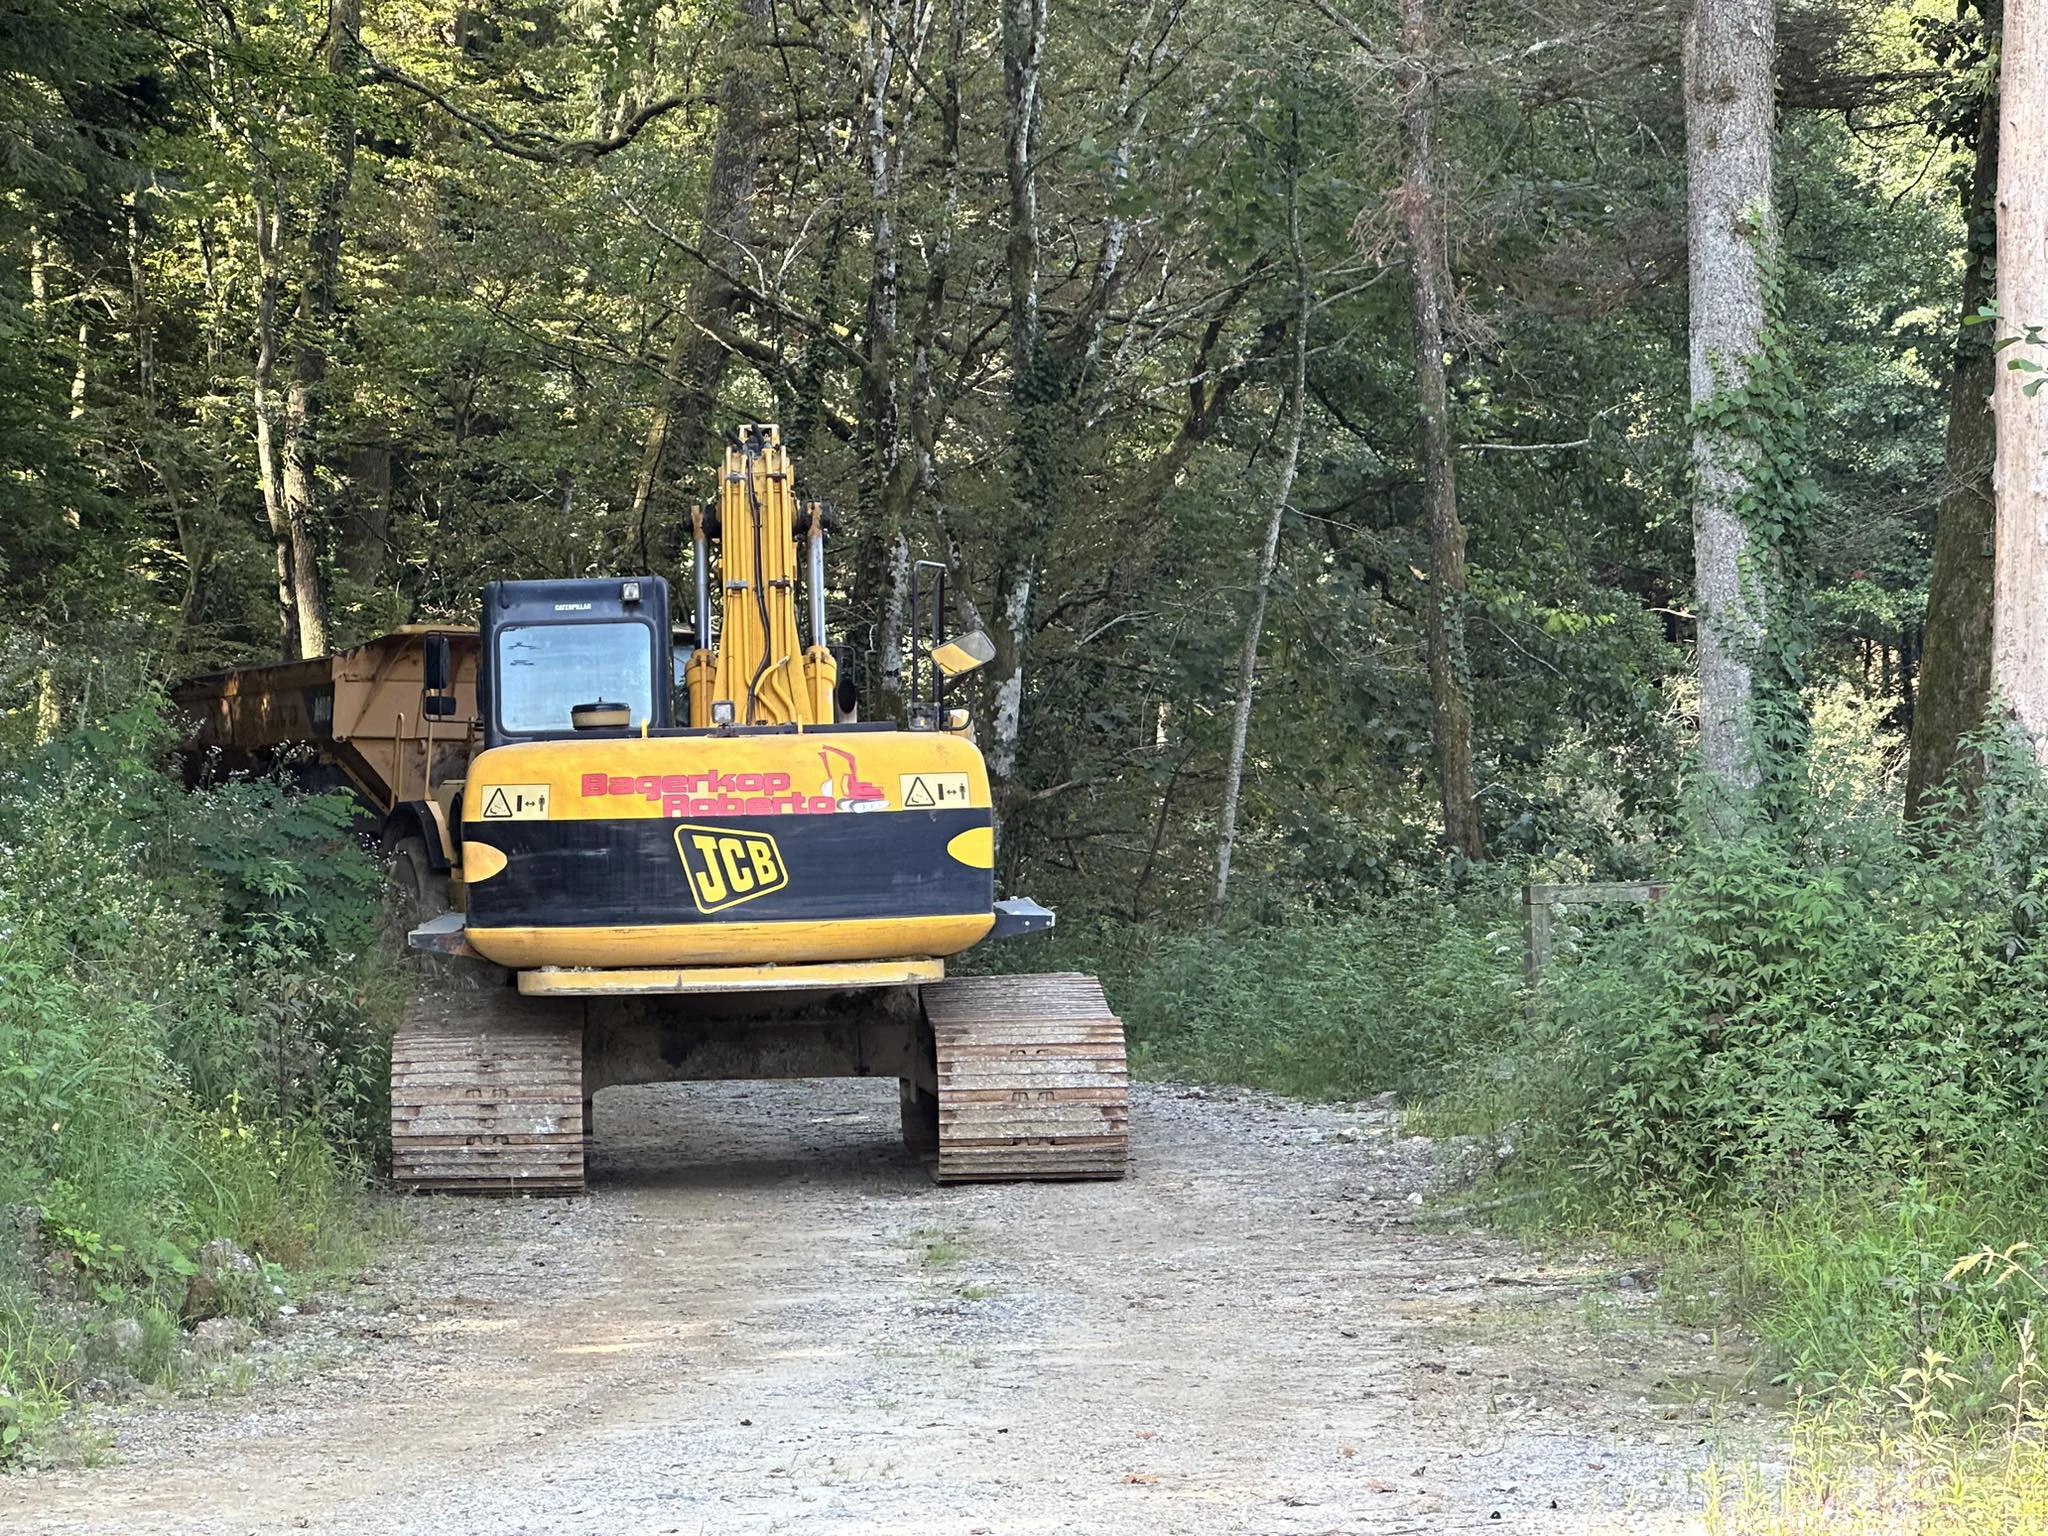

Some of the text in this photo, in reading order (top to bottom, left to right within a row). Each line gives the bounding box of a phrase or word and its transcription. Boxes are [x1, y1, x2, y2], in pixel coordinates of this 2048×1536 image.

[554, 603, 592, 611] CATERPILLAR
[581, 769, 791, 801] Bagerkop
[663, 791, 836, 818] Roberto
[691, 834, 779, 903] JCB
